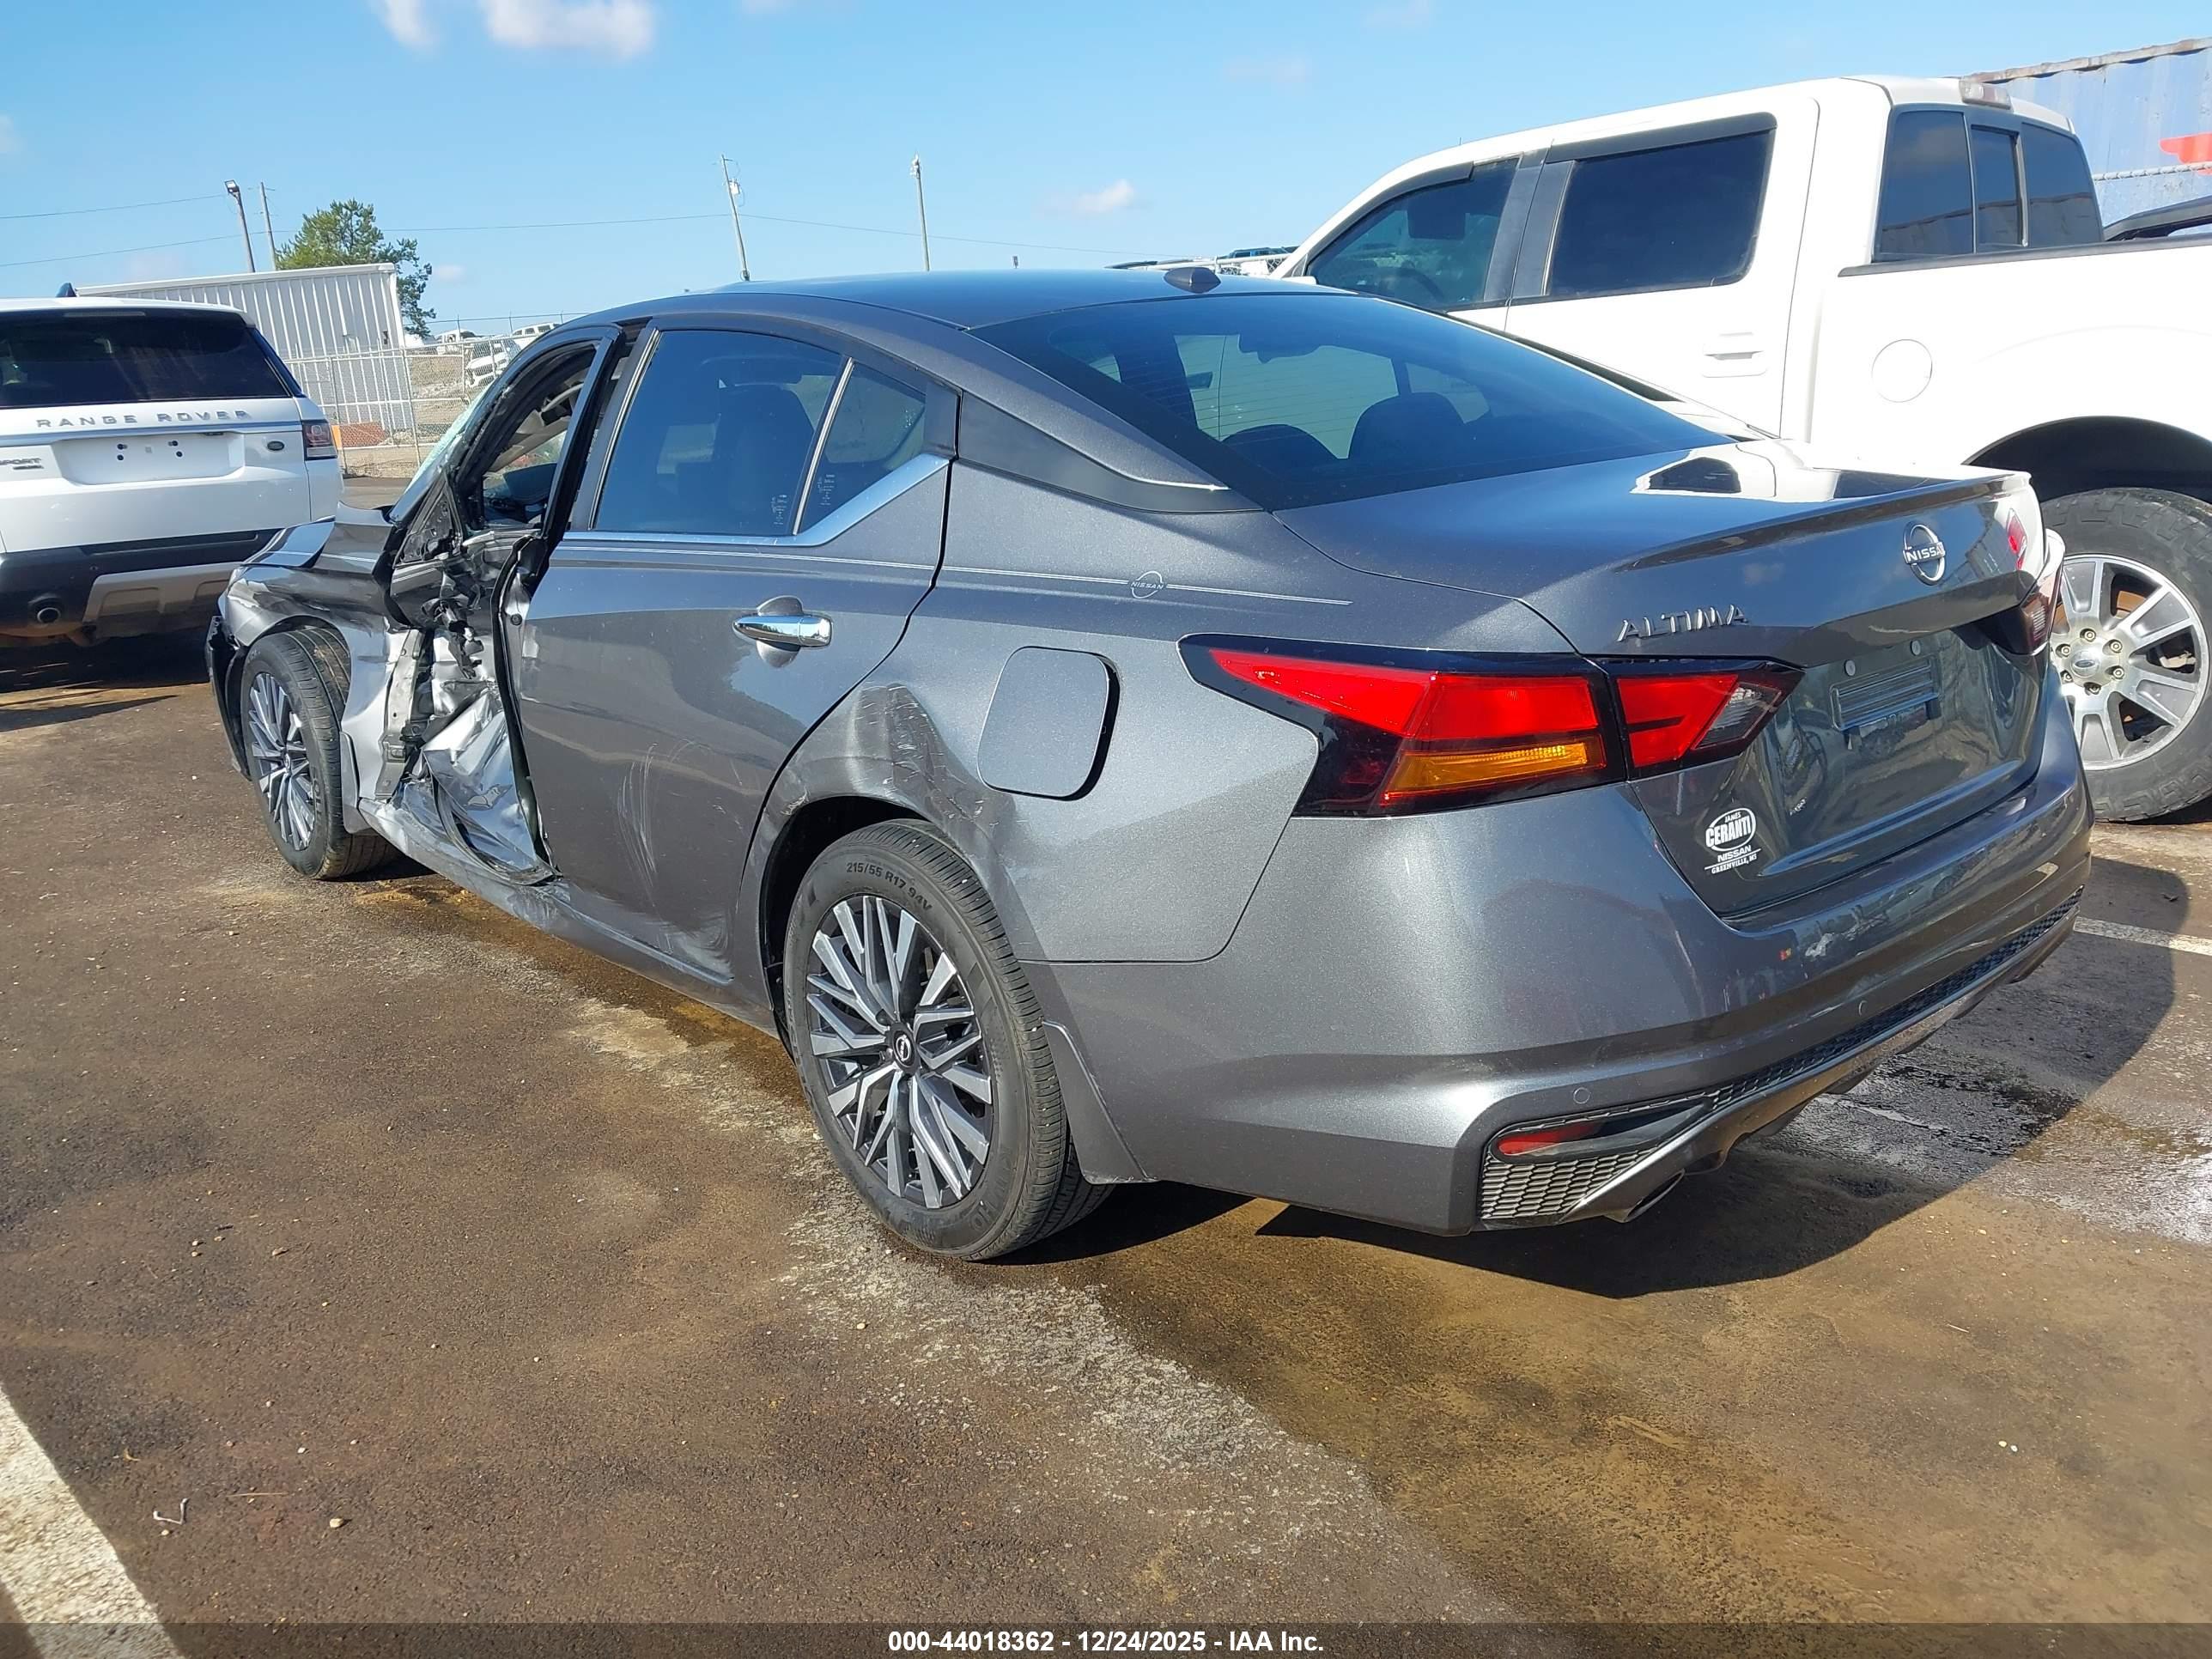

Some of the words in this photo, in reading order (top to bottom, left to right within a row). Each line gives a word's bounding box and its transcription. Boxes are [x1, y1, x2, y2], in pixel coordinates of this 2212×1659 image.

[37, 415, 137, 428] RANGE
[157, 410, 252, 422] ROVER
[1131, 581, 1164, 590] NISSAN
[1616, 604, 1751, 642] ALTIMA
[1724, 811, 1741, 823] JAMES
[1705, 814, 1752, 848] CERANTI
[1717, 844, 1752, 862] NISSAN
[1711, 857, 1749, 874] GREENVILLE,
[847, 862, 884, 877] 215/55
[885, 871, 907, 889] R17
[908, 887, 933, 911] 94V
